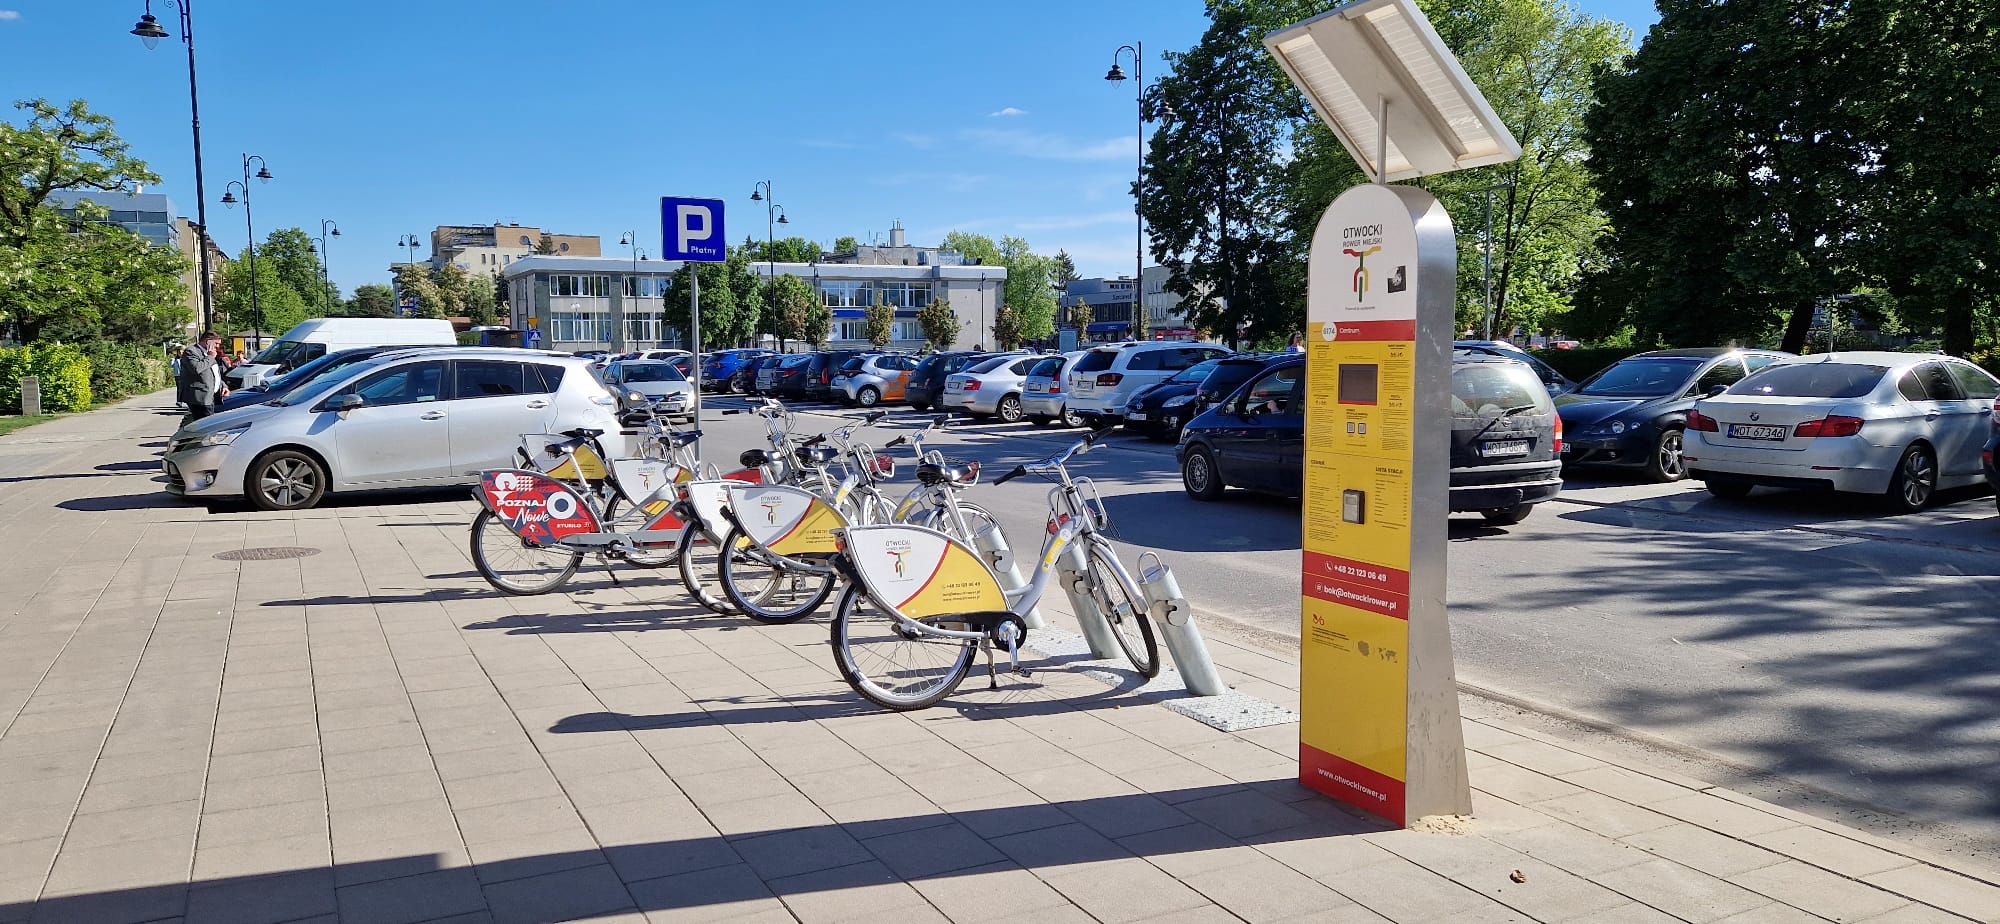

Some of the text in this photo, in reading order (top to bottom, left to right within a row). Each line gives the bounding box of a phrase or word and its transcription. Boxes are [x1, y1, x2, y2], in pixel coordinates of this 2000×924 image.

[677, 205, 712, 253] P
[1343, 224, 1383, 239] OTWOCKI
[691, 246, 717, 256] Płatny
[1734, 425, 1784, 438] WOT 67346
[513, 507, 551, 528] Nowe
[1334, 565, 1387, 582] +48 22 123 06 49
[1324, 585, 1397, 610] bok@otwockirower.pl
[1318, 767, 1387, 803] www.otwockirower.pl
